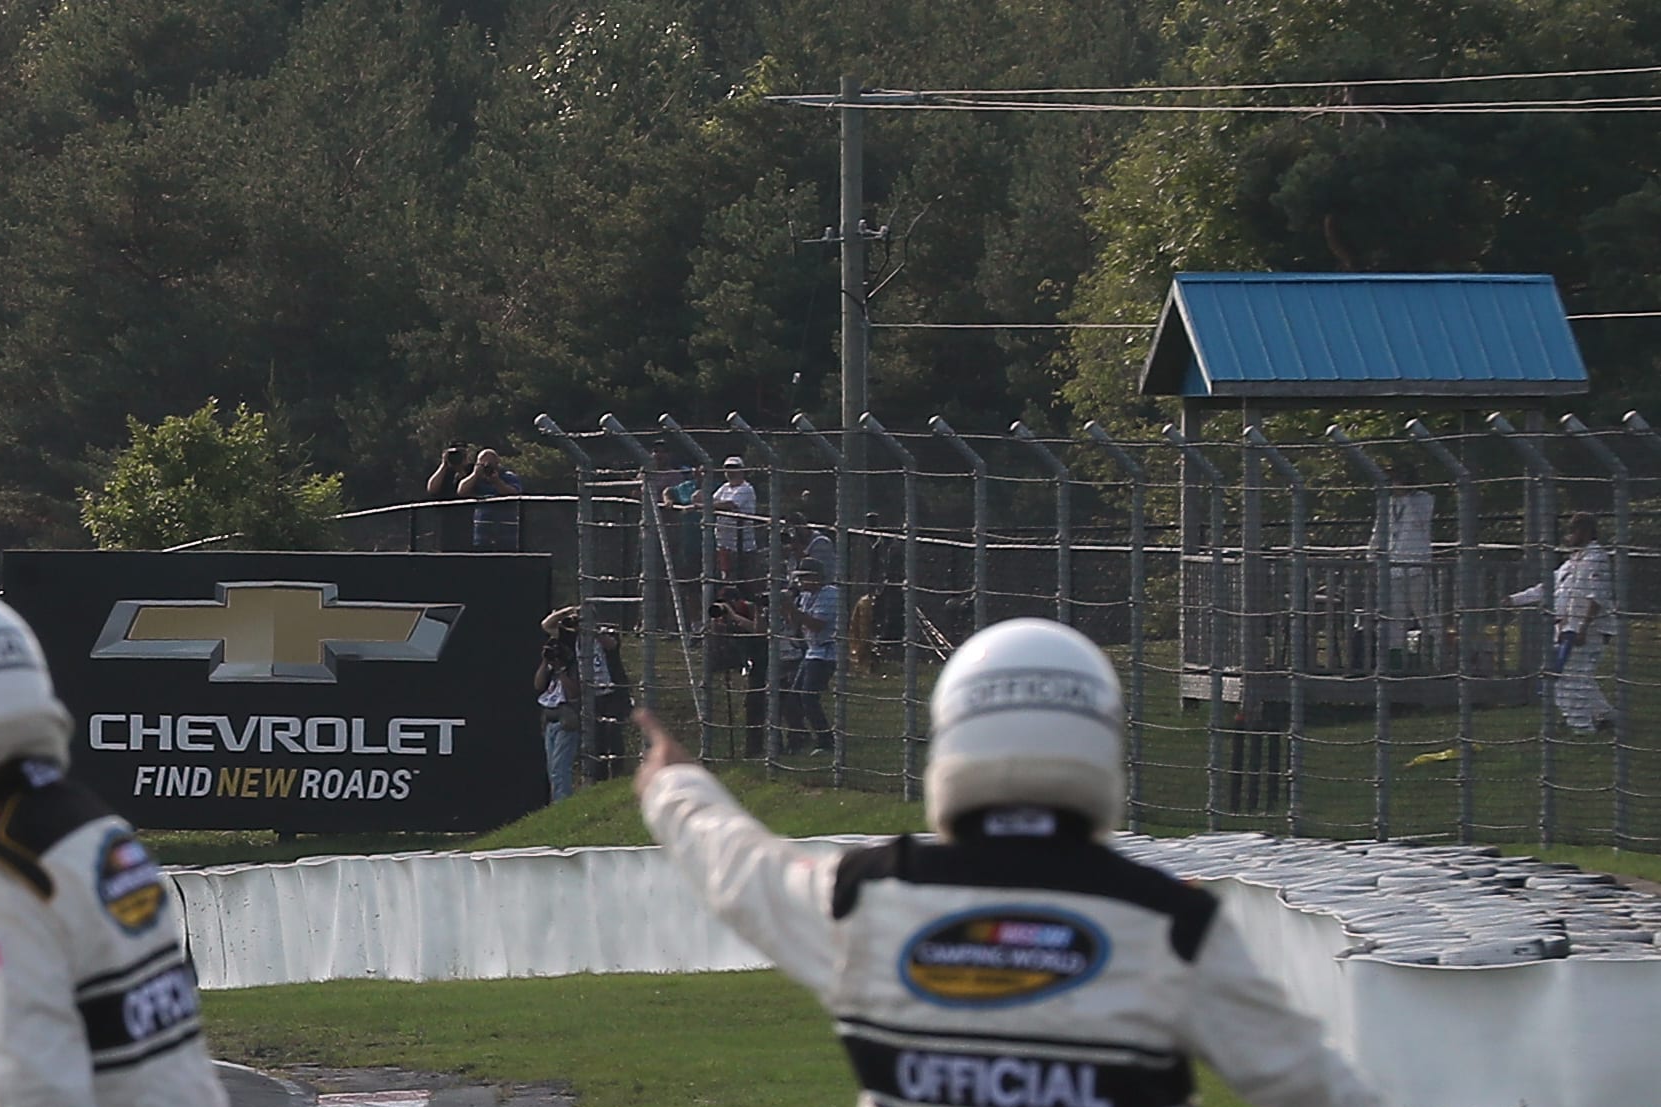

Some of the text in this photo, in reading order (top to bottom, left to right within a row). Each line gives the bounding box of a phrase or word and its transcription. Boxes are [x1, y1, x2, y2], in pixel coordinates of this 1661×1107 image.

[90, 714, 466, 755] CHEVROLET
[134, 766, 412, 800] FIND NEW ROADS
